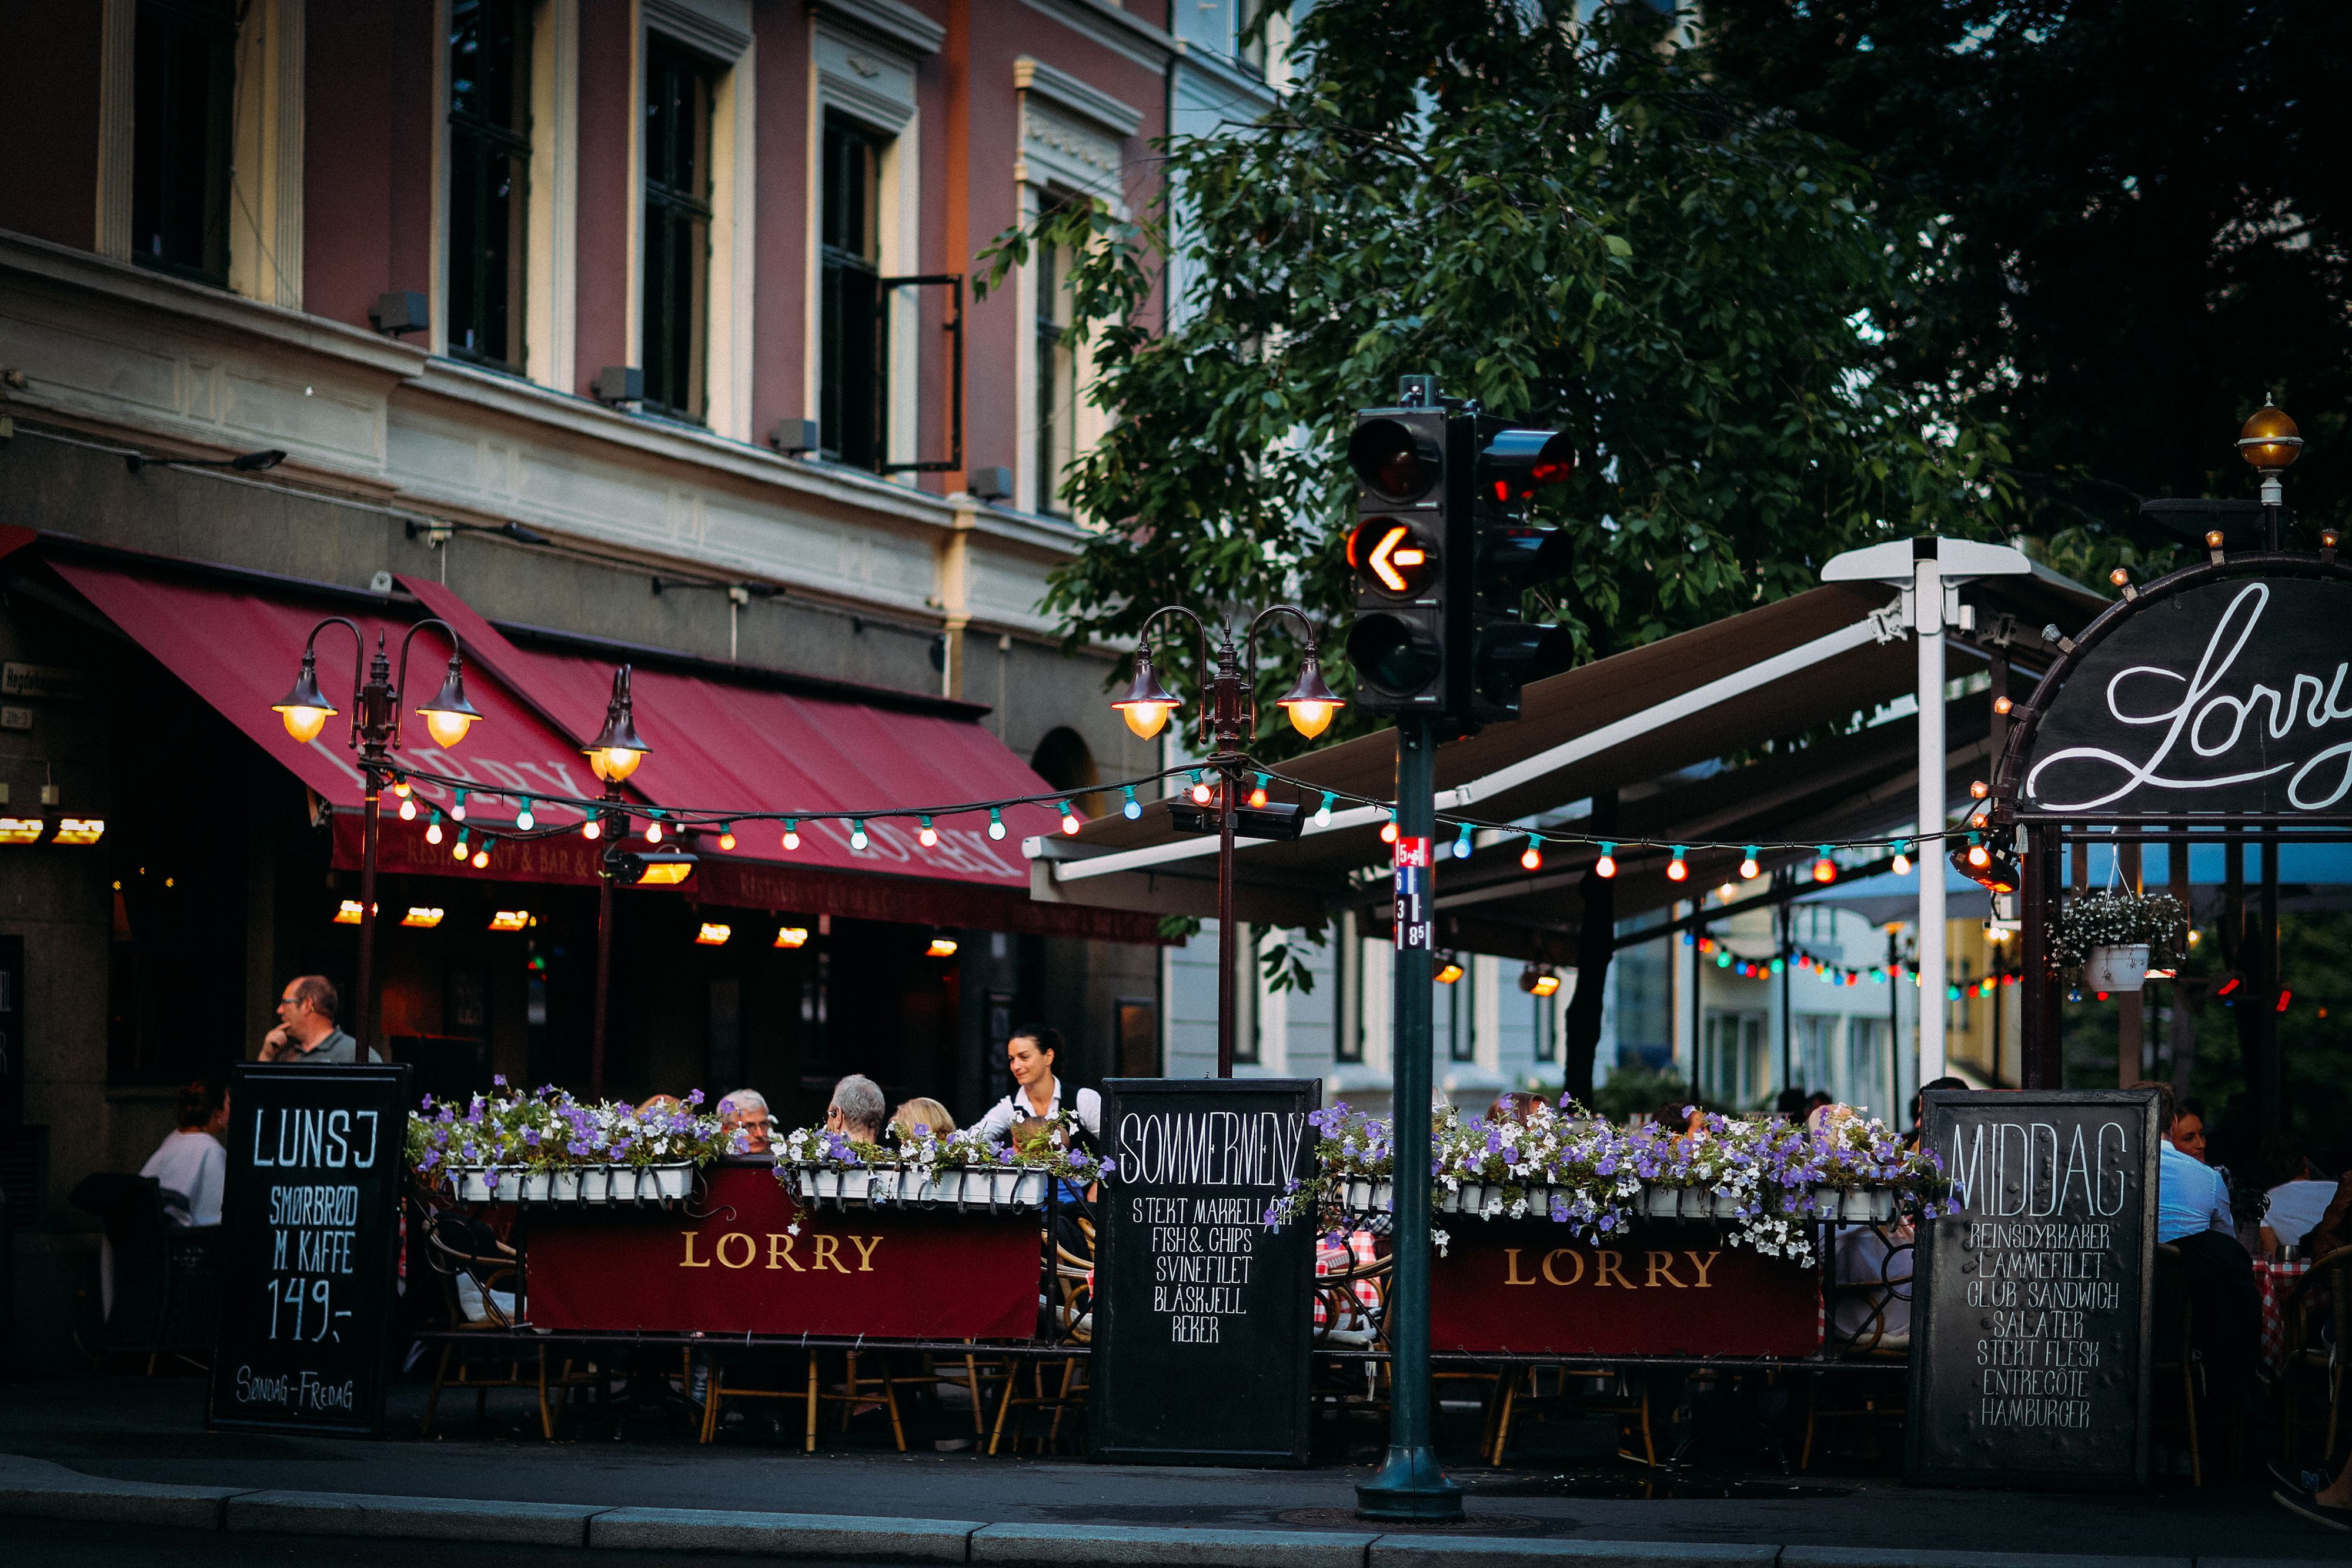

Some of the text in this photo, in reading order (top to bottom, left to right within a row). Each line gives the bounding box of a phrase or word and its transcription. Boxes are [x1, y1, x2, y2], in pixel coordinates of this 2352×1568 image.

[539, 845, 569, 874] BAR
[1396, 871, 1402, 891] 6
[1397, 900, 1405, 919] 3
[253, 1109, 378, 1168] LUNSJ
[1118, 1112, 1305, 1185] SOMMERMENY
[1946, 1122, 2127, 1216] MIDDAG
[269, 1185, 358, 1226] SMØRBRØD
[1132, 1197, 1188, 1224] STEKT
[1209, 1227, 1252, 1253] CHIPS
[1969, 1223, 2110, 1249] REINSDYRKAKER
[298, 1230, 355, 1273] KAFFE
[679, 1231, 884, 1273] LORRY
[1979, 1252, 2105, 1279] LAMMEFILET
[1156, 1256, 1253, 1284] SVINEFILET
[1504, 1248, 1721, 1289] LORRY
[1154, 1284, 1247, 1315] BLÅSKJELL
[1967, 1281, 2119, 1309] CLUB SANDWICH
[1172, 1315, 1219, 1343] REKER
[1993, 1310, 2083, 1338] SALATER
[1977, 1339, 2099, 1367] STEKT FLESK
[1983, 1367, 2089, 1397] ENTRECÔTE
[1982, 1398, 2090, 1428] HAMBURGER
